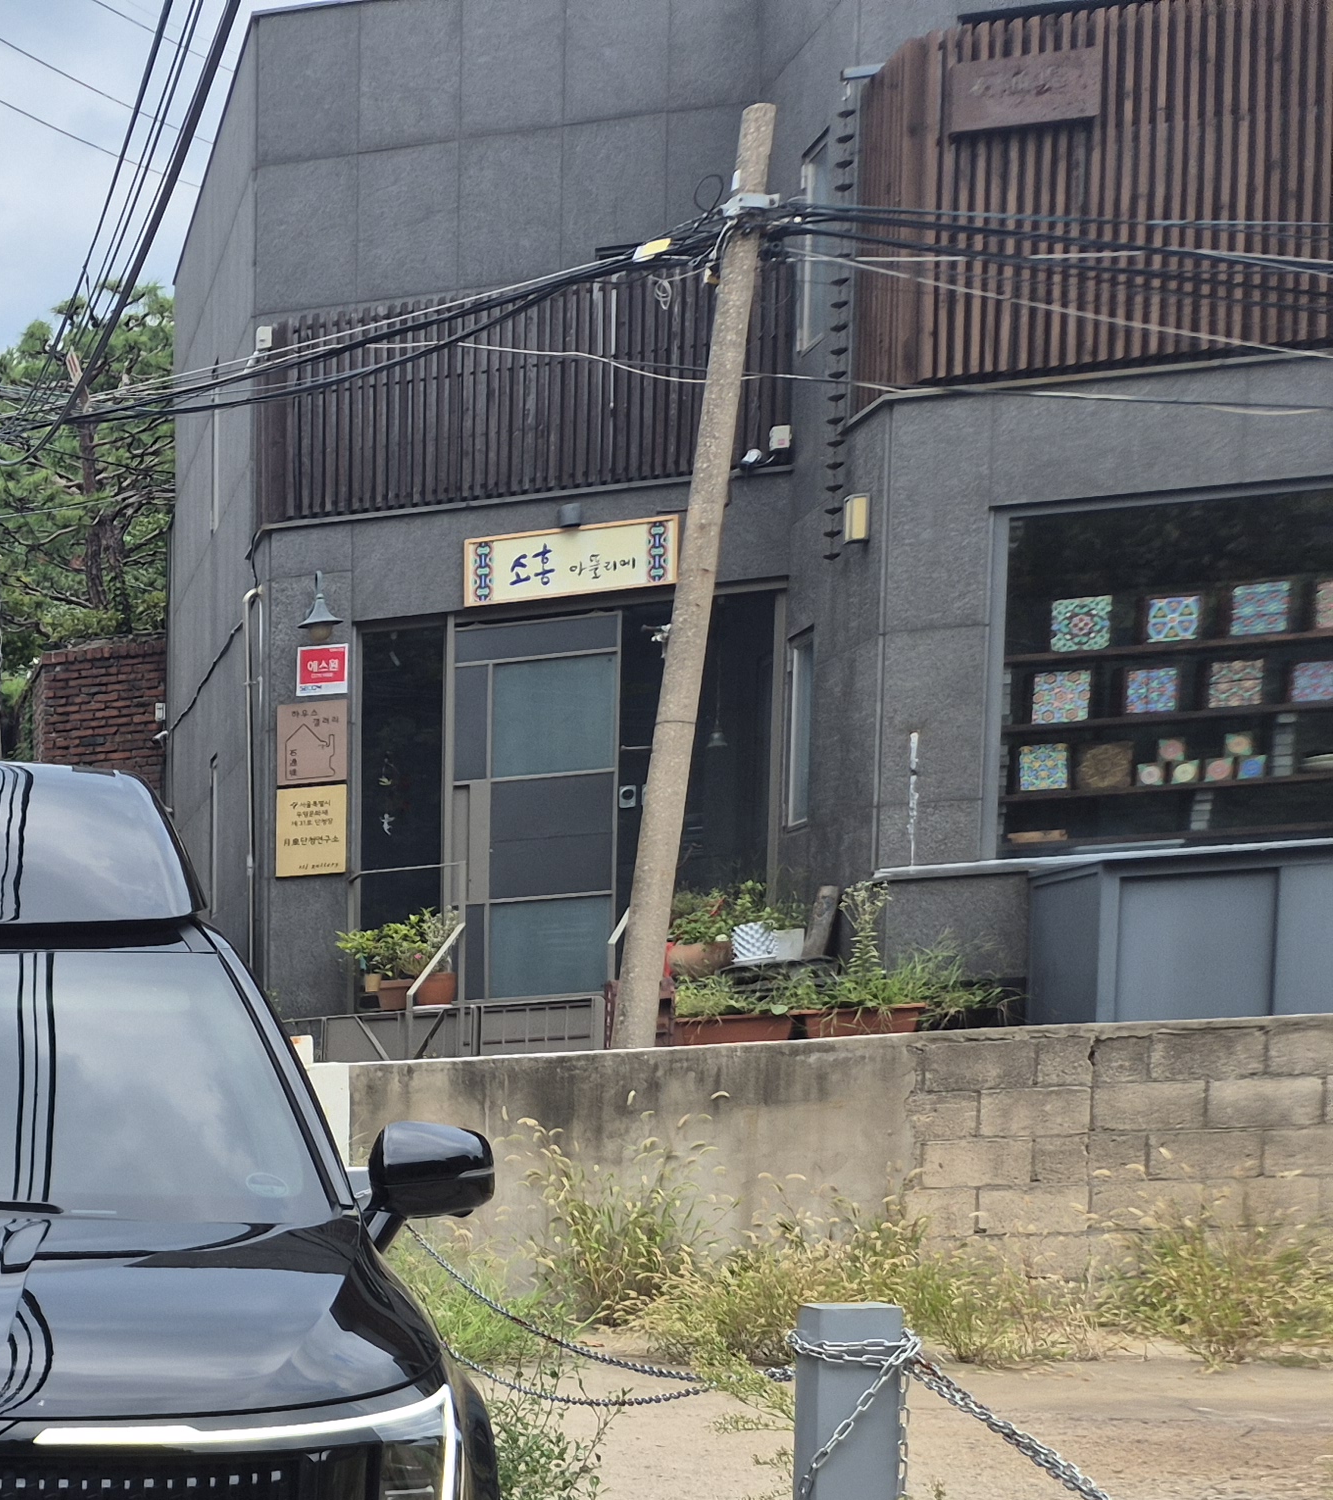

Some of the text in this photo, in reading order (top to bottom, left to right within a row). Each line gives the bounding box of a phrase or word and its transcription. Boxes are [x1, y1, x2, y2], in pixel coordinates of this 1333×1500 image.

[509, 543, 556, 586] 소홍
[307, 658, 339, 672] 에스원
[291, 709, 318, 718] 하우스
[313, 716, 339, 727] 갤러리
